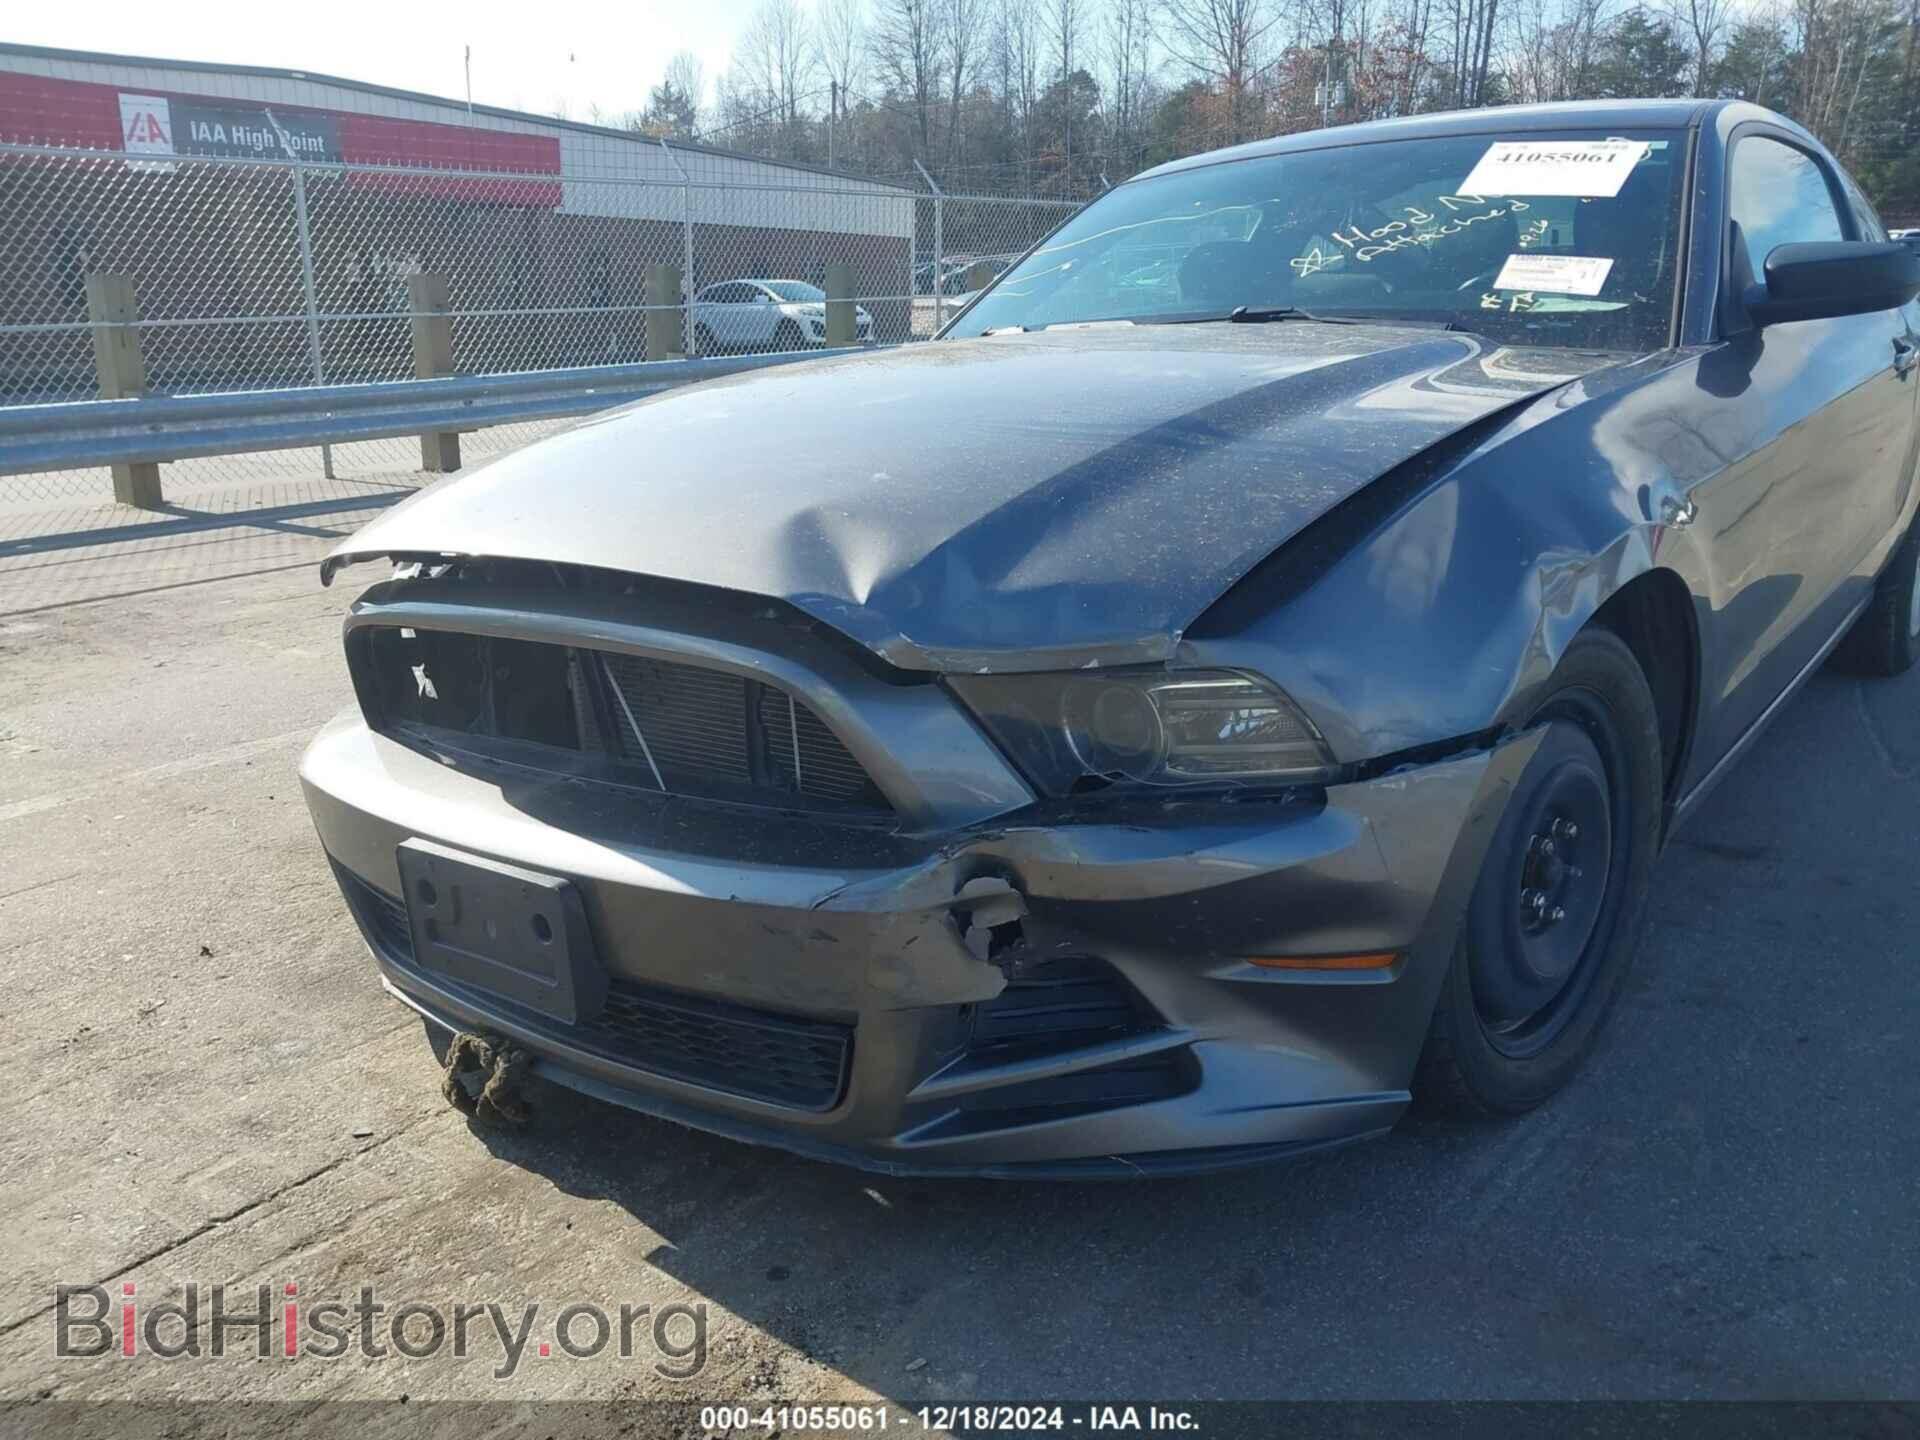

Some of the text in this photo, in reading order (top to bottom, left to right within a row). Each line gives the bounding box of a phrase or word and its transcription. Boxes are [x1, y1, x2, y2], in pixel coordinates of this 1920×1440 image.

[190, 120, 325, 152] IAA High Point
[1496, 152, 1618, 164] 41055061
